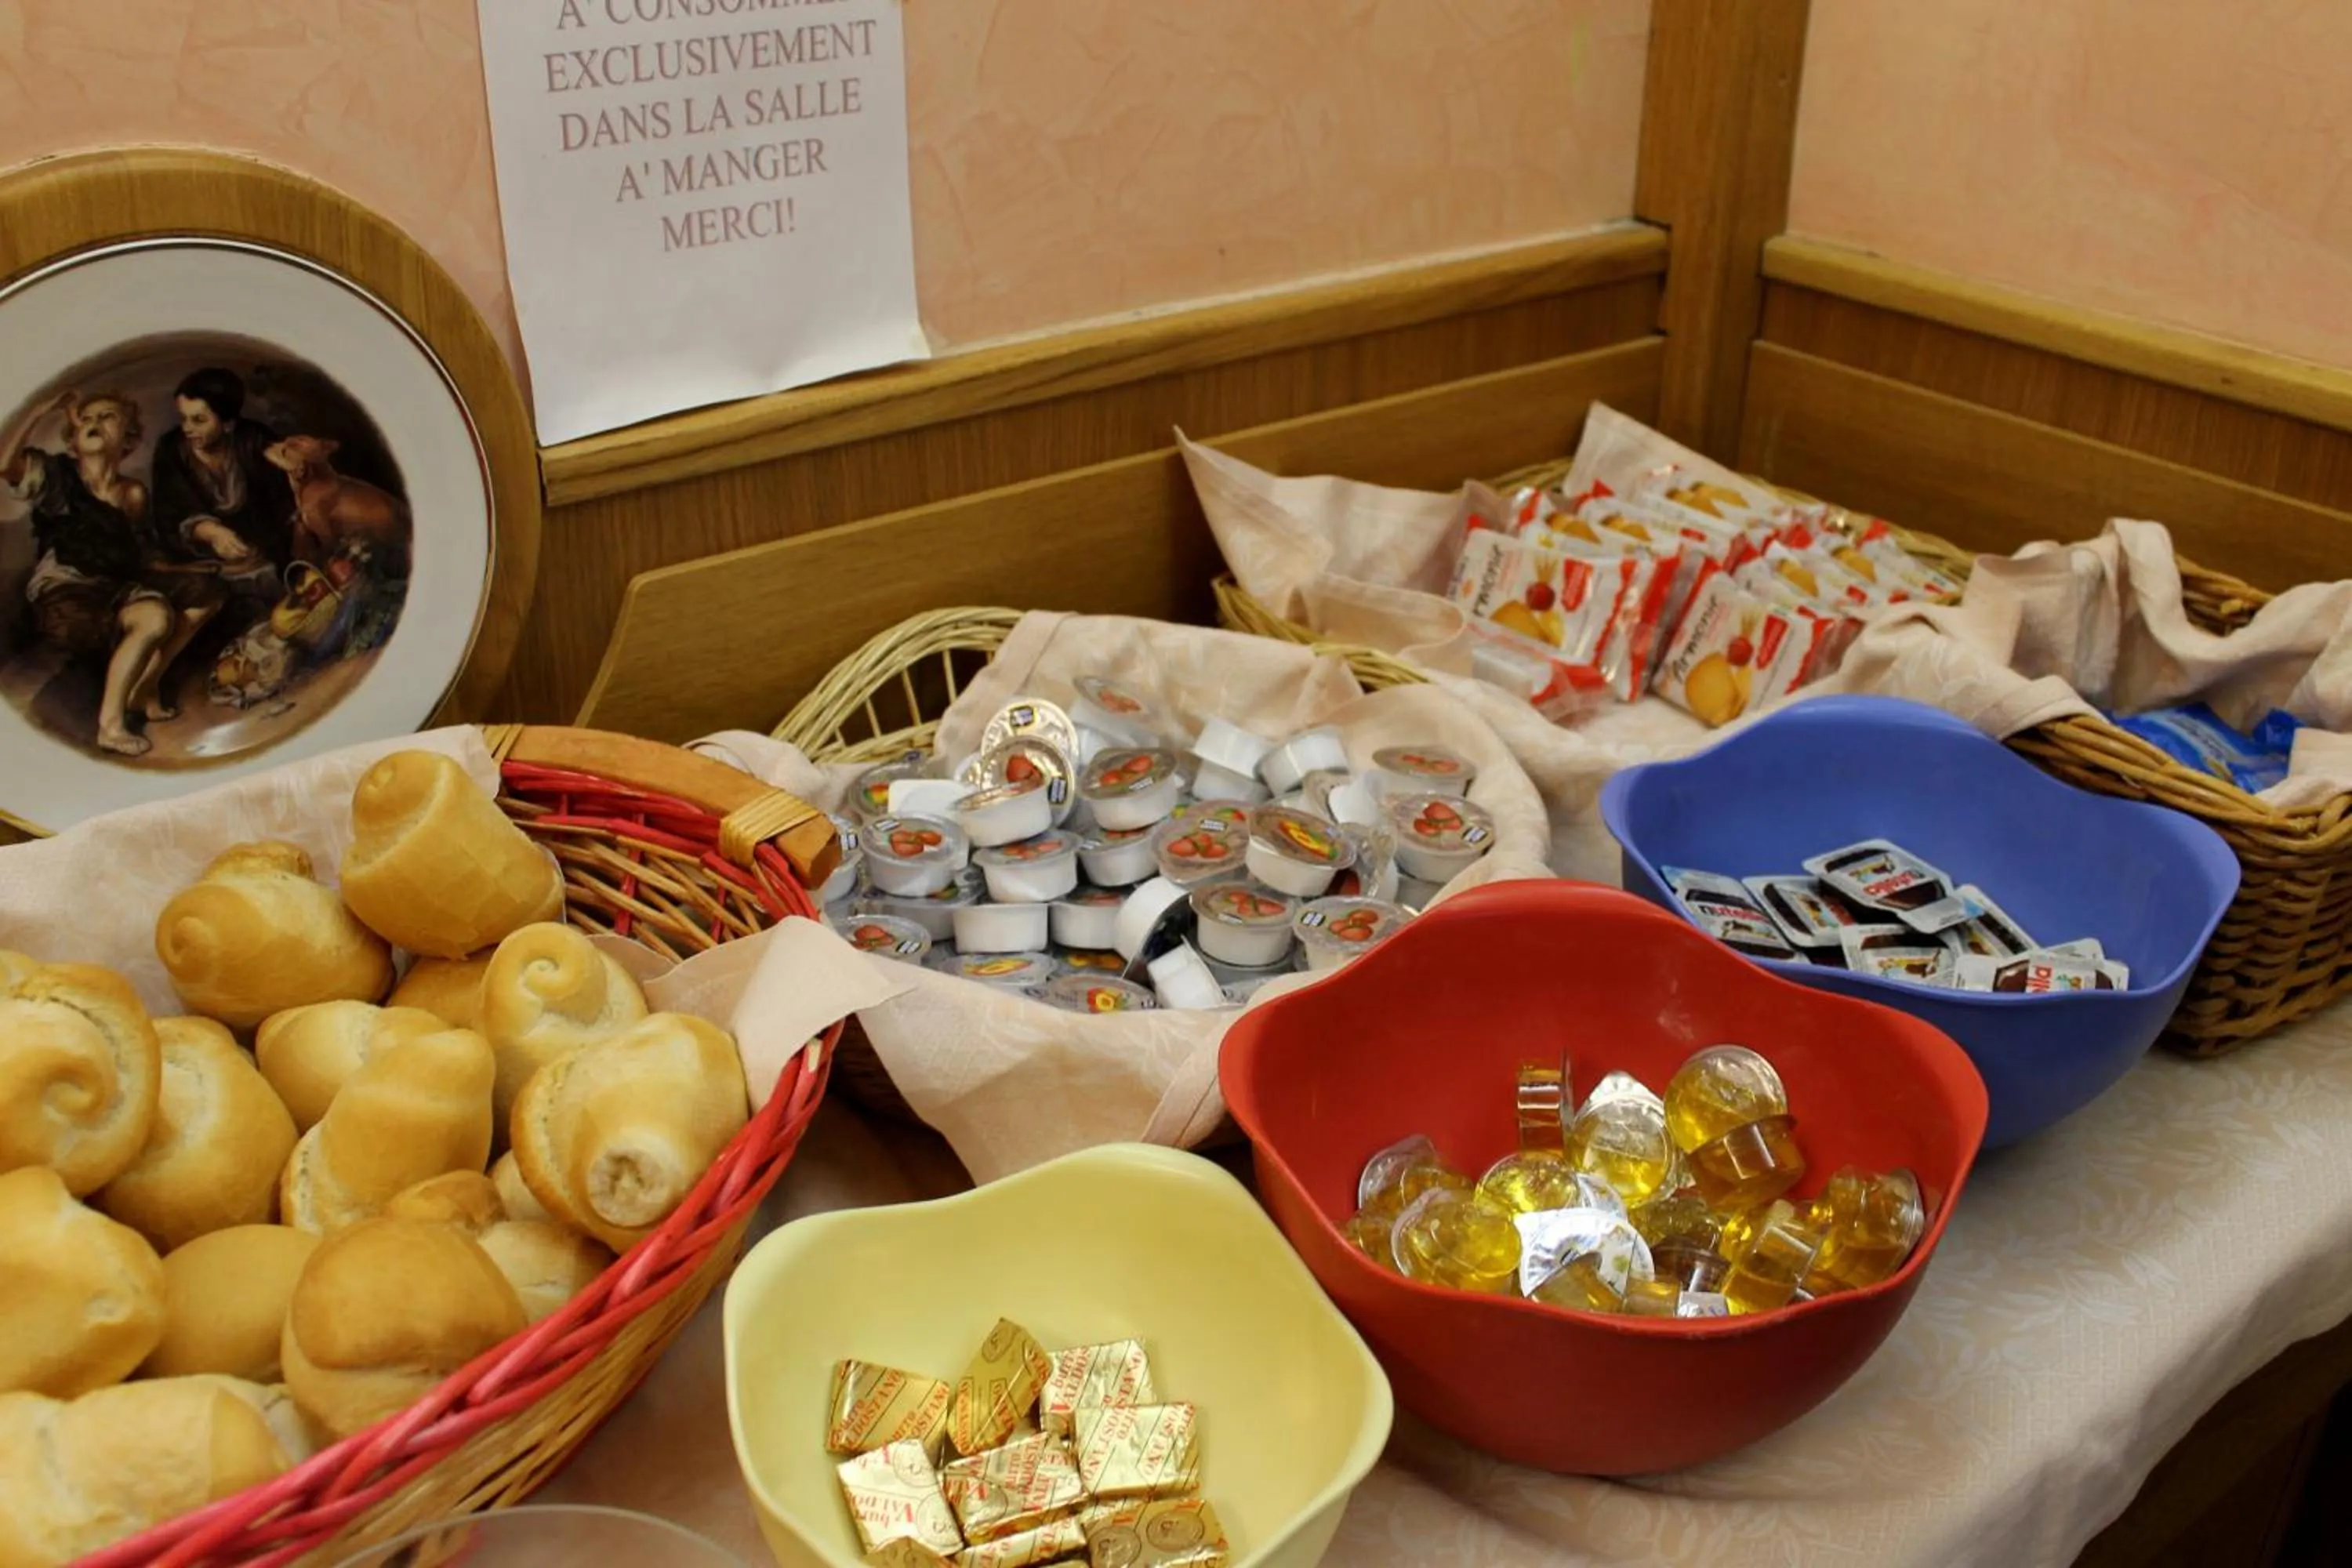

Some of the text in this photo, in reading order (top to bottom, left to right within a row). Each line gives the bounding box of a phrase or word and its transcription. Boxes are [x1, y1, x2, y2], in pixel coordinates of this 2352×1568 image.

[556, 0, 592, 30] A
[544, 20, 877, 93] EXCLUSIVEMENT
[559, 78, 862, 152] DANS LA SALLE
[615, 138, 828, 202] A' MANGER
[662, 198, 796, 252] MERCI!
